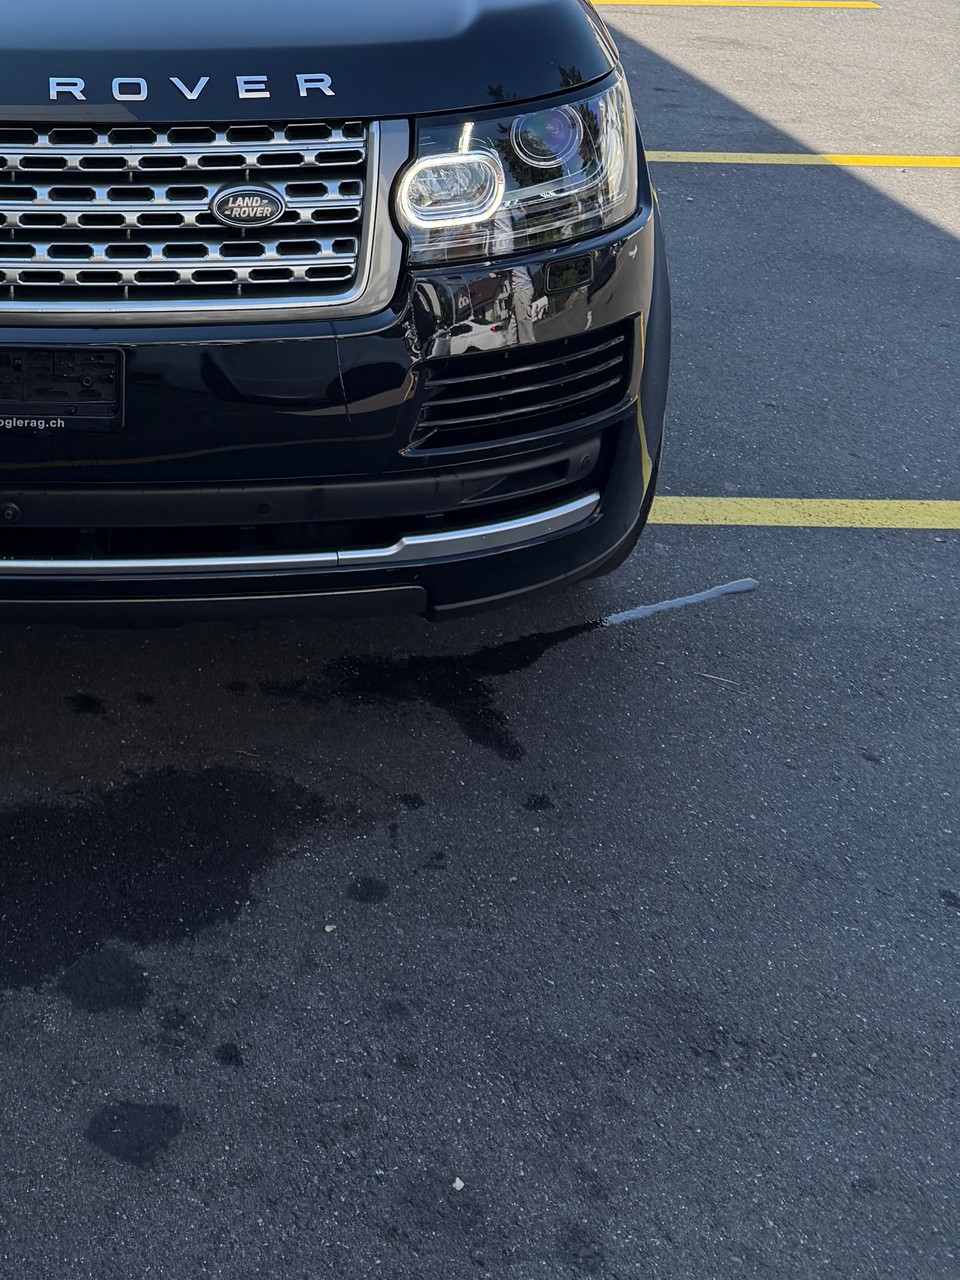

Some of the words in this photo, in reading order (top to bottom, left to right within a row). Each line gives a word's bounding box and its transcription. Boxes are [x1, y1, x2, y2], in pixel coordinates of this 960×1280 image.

[49, 73, 336, 101] ROVER
[228, 196, 261, 207] LAND
[231, 207, 272, 218] ROVER
